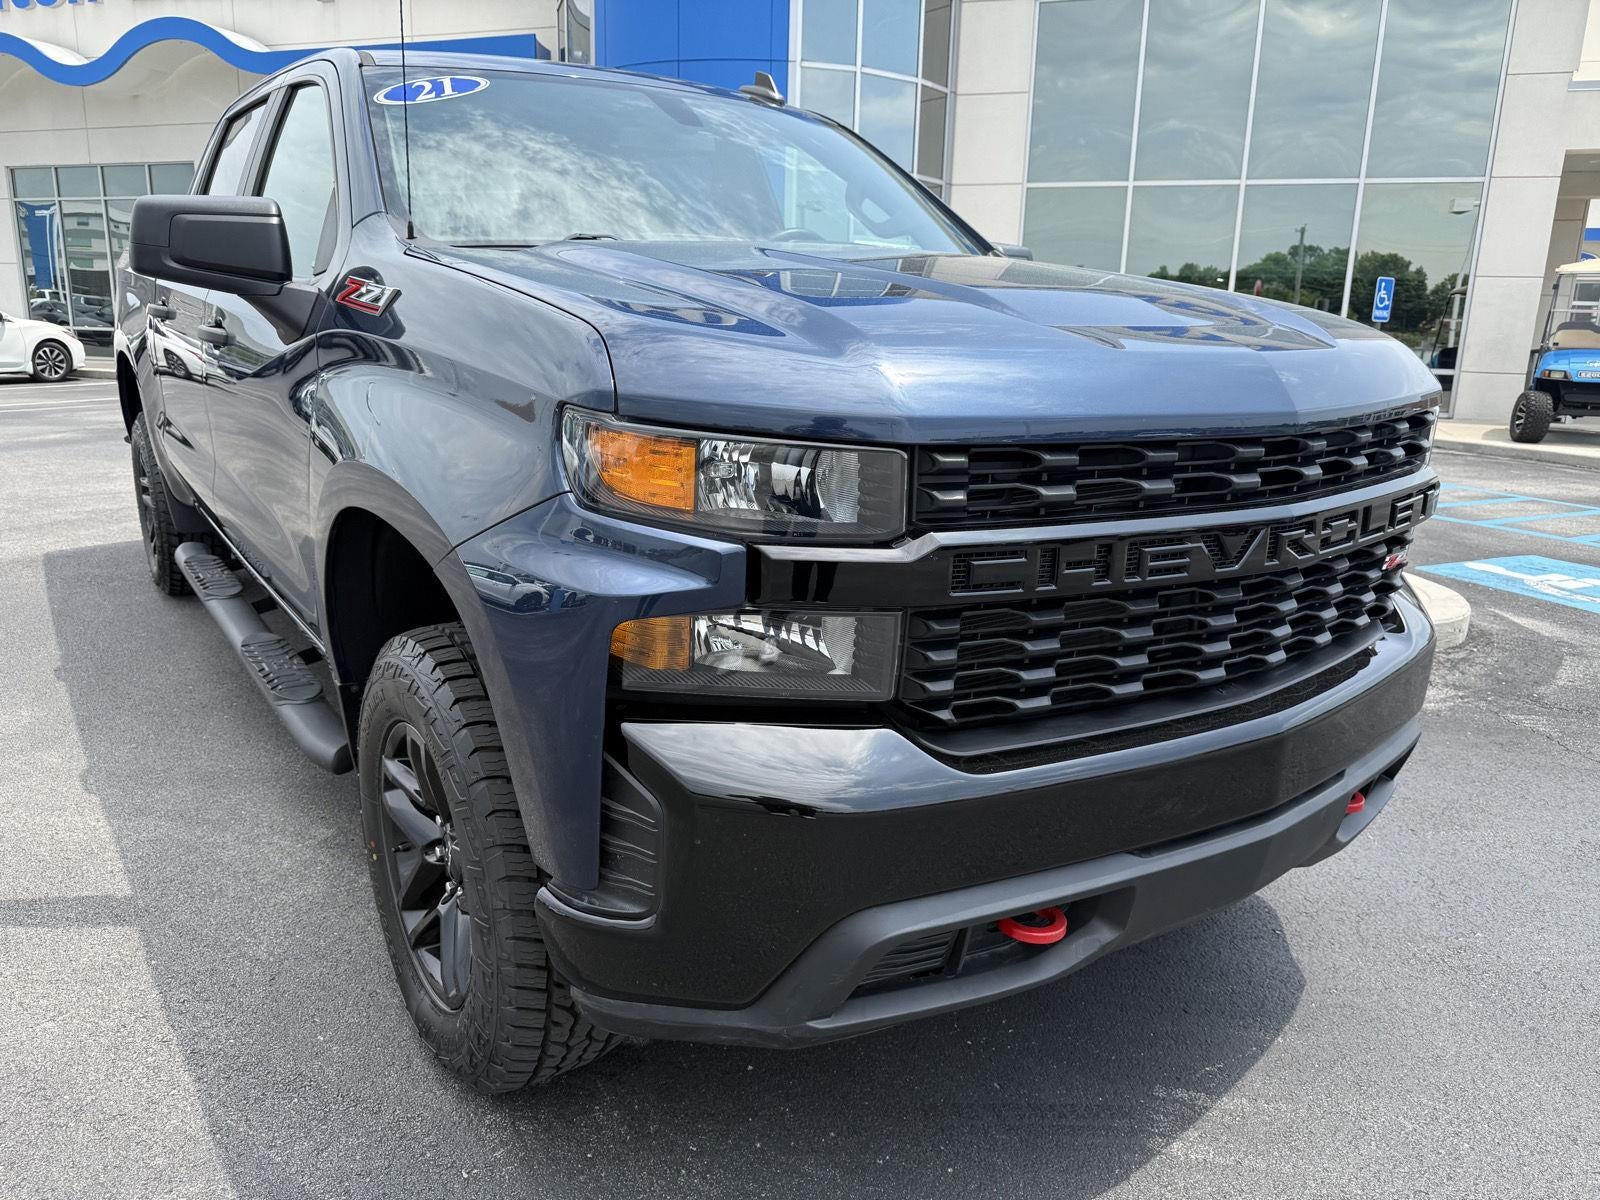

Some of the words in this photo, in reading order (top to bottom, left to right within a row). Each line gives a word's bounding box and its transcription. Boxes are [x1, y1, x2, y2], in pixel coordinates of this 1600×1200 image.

[411, 77, 459, 101] 21
[335, 275, 403, 317] Z71
[948, 483, 1439, 597] CHEVROLET
